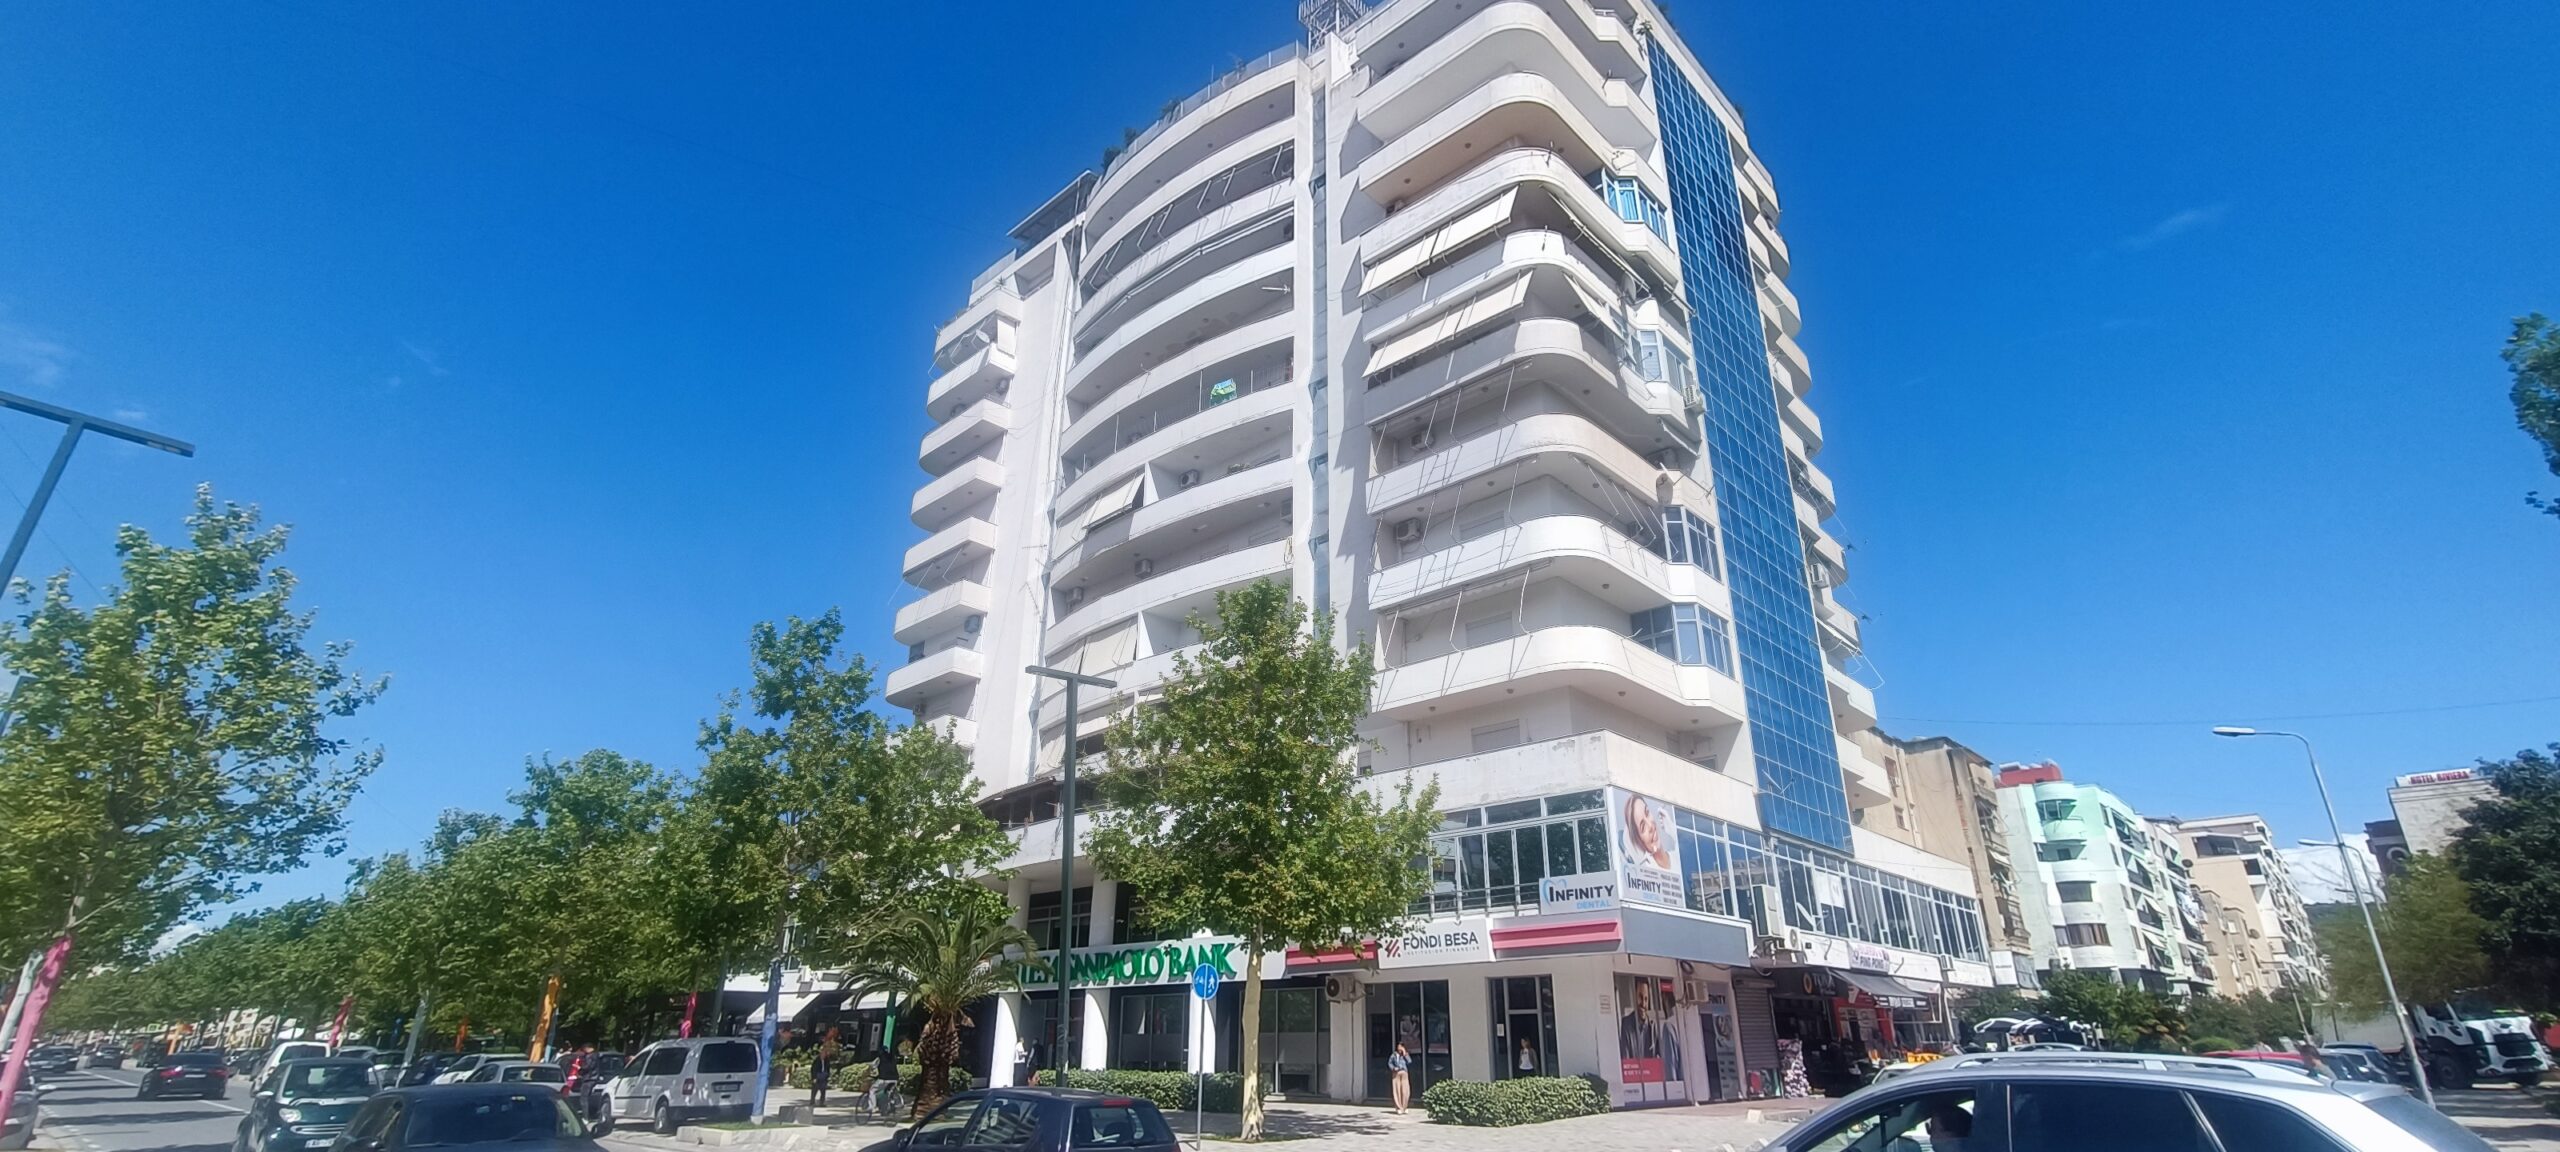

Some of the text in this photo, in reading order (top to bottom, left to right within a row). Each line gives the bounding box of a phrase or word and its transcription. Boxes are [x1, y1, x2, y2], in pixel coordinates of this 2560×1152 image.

[2437, 771, 2469, 782] RIVIERA
[1627, 872, 1661, 893] INFINITY
[1549, 885, 1614, 902] INFINITY
[1577, 900, 1611, 909] DENTAL
[1403, 931, 1479, 951] FONDI BESA
[1167, 942, 1237, 980] BANK
